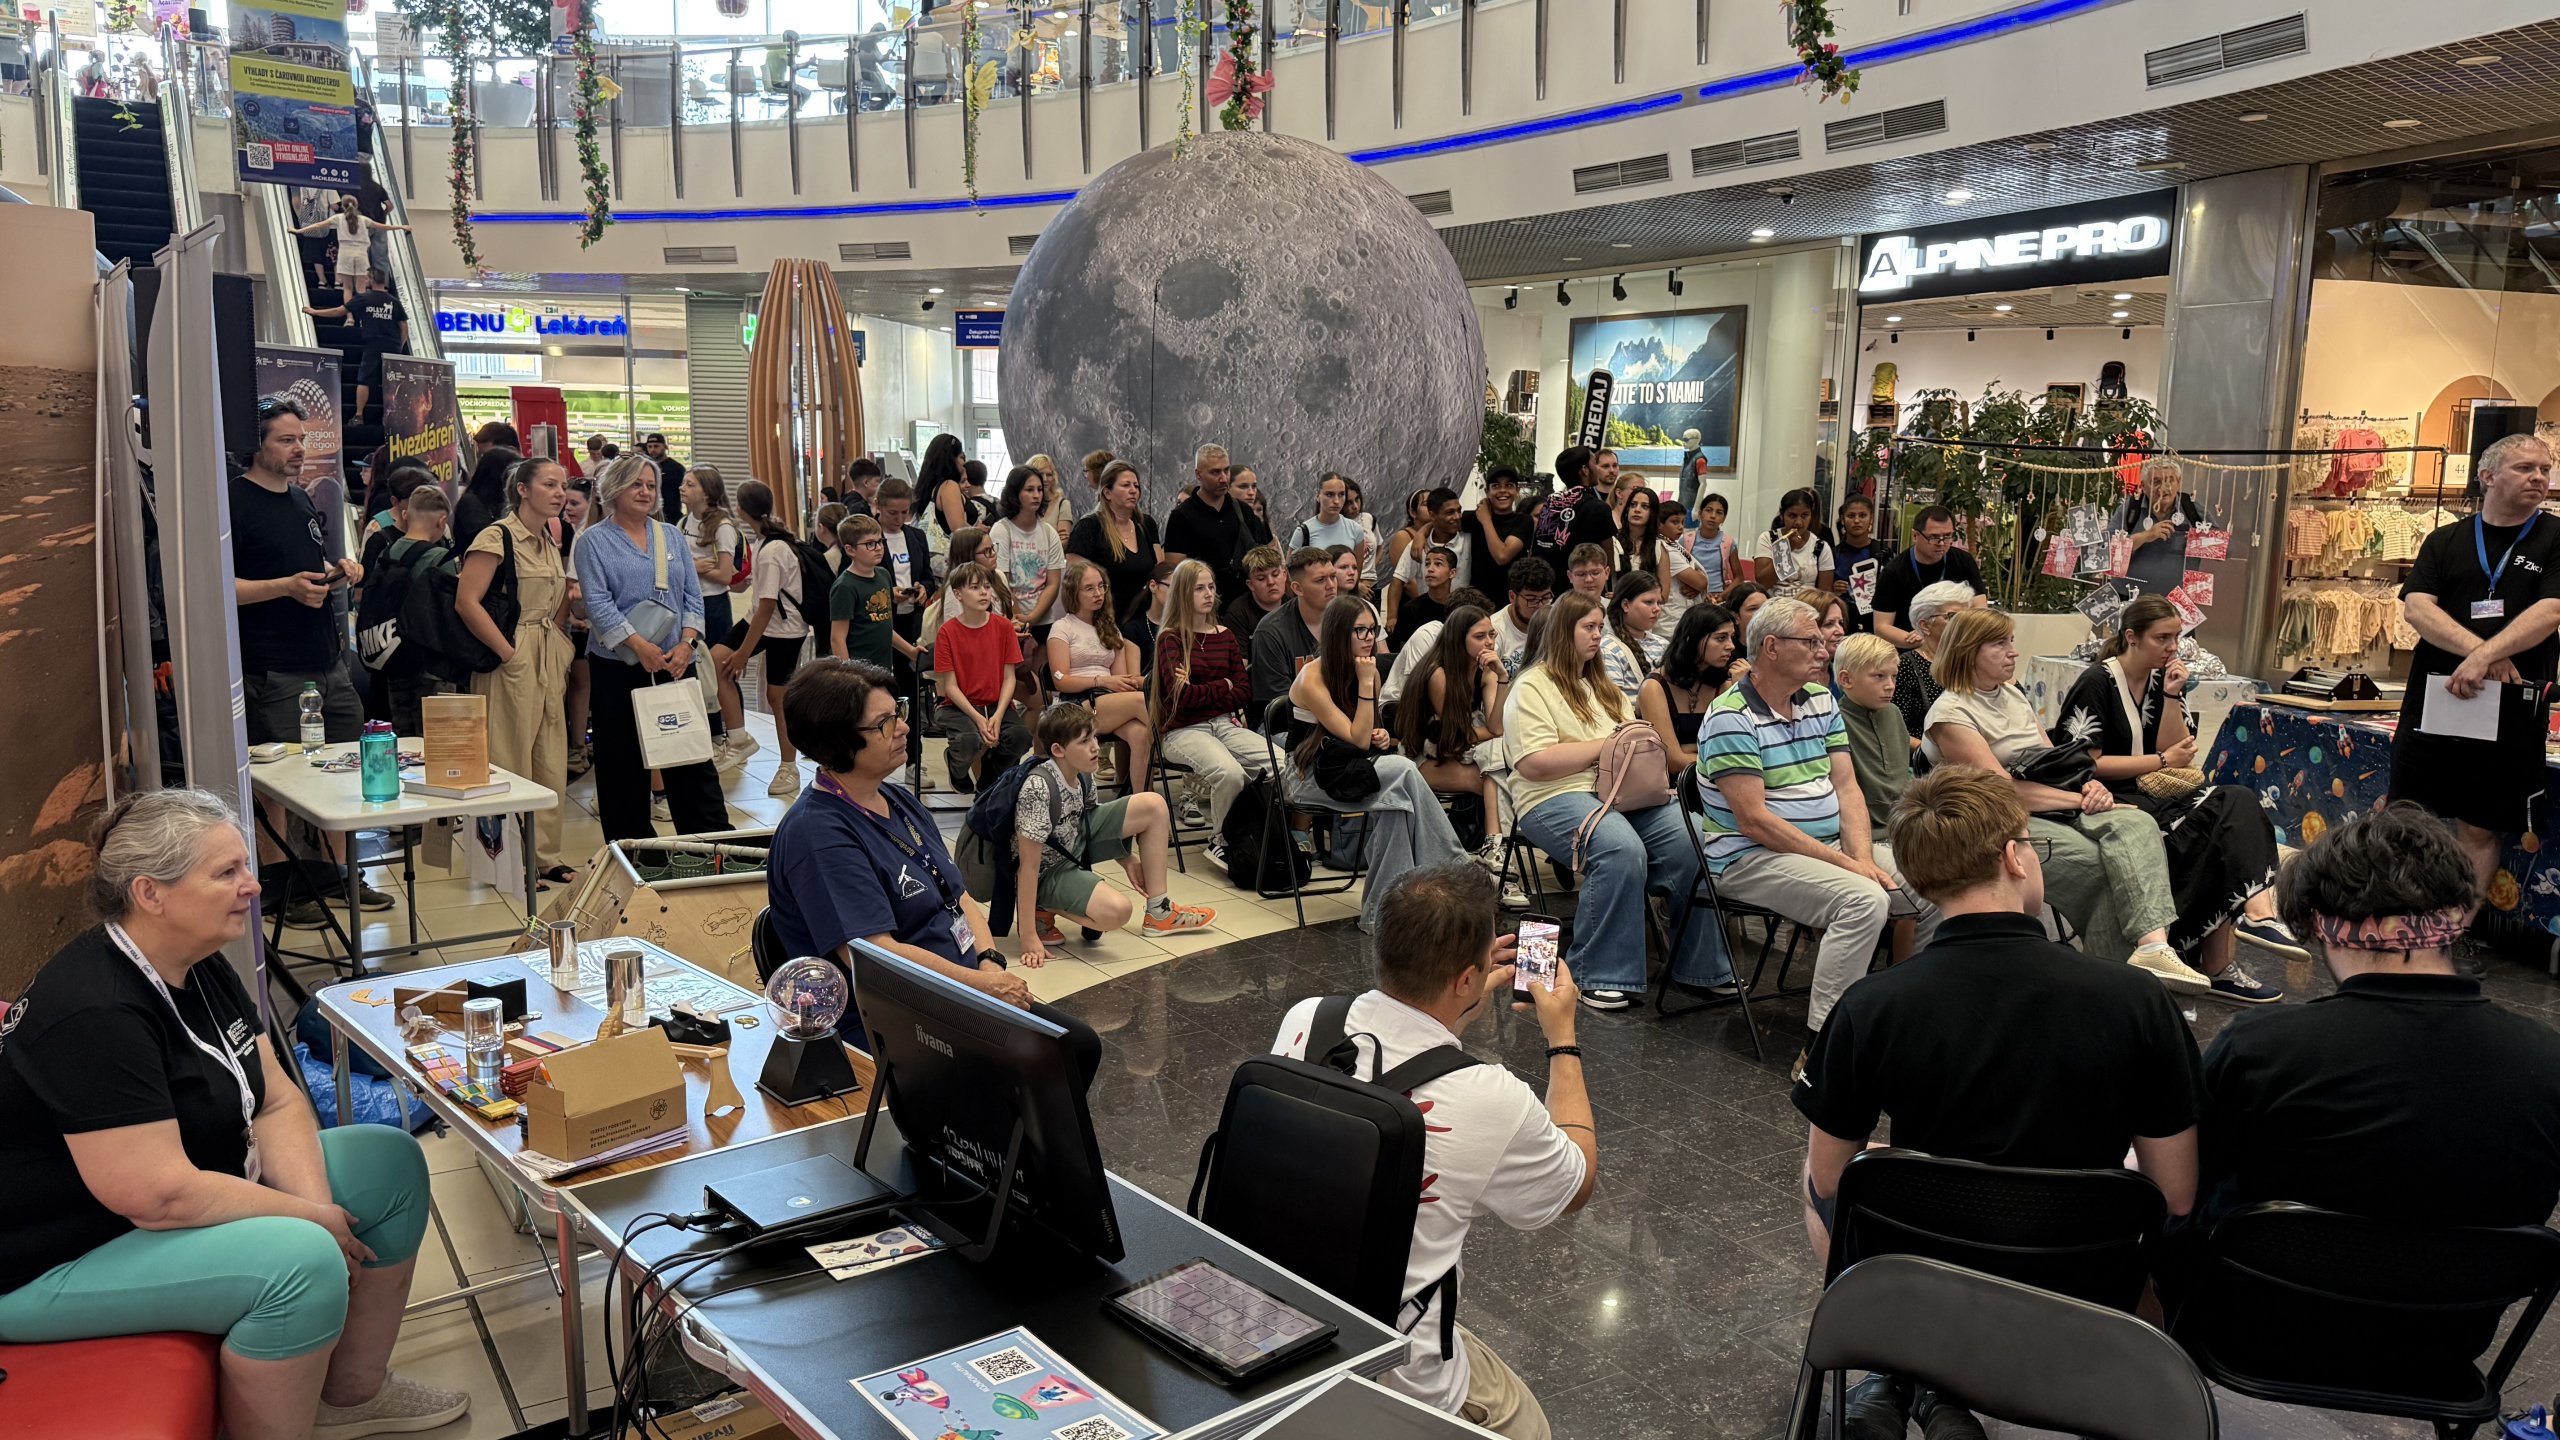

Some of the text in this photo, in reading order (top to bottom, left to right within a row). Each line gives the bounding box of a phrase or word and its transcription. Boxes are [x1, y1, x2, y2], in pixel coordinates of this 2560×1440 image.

[2041, 215, 2162, 261] PRO
[436, 312, 627, 336] BENU Lekáreň
[1639, 382, 1654, 404] TO
[1656, 382, 1665, 404] S
[1667, 380, 1705, 403] NAMI!
[389, 417, 456, 462] Hvezdáreň
[359, 617, 397, 657] NIKE
[915, 1024, 954, 1058] iiyama
